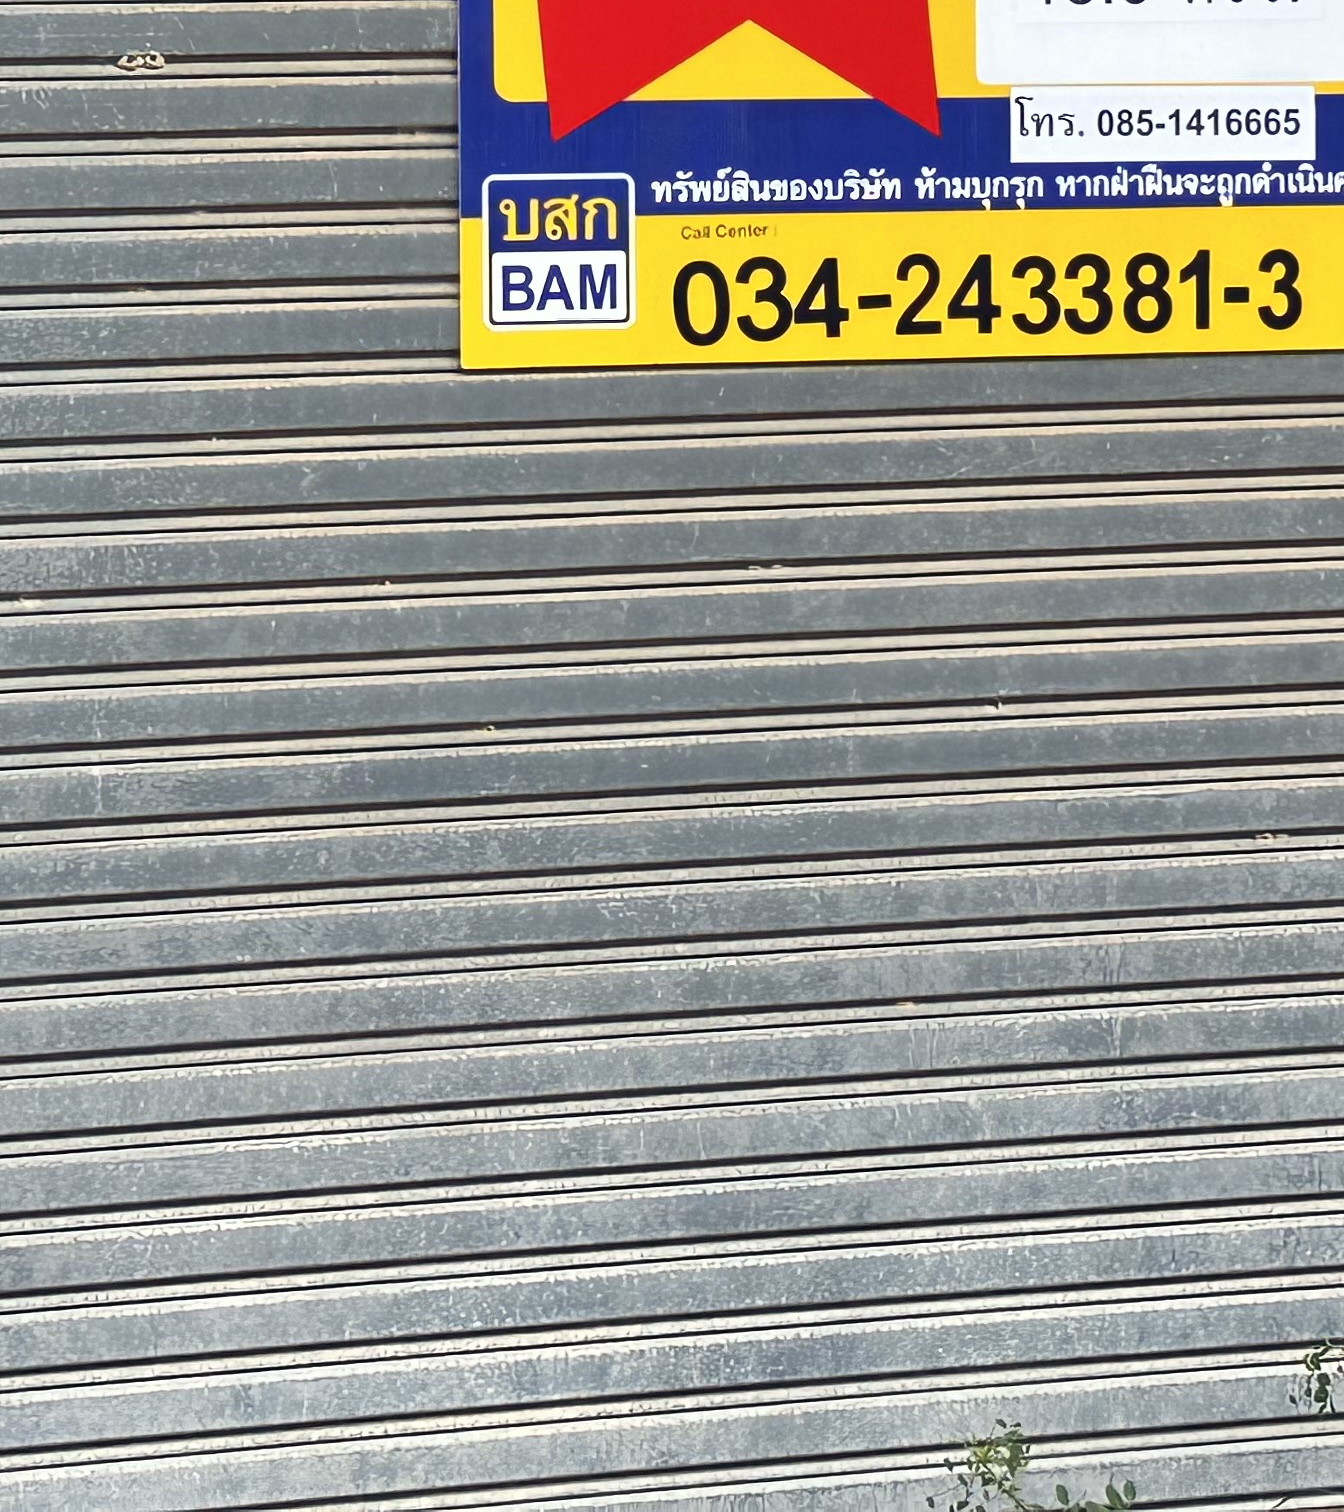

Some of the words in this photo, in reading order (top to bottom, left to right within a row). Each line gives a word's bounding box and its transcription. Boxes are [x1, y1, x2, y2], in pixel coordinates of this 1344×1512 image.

[1014, 97, 1085, 138] โทร.
[1096, 107, 1302, 138] 085-1416665
[650, 166, 902, 204] ทรัพย์สินของบริษัท
[914, 165, 1045, 210] ห้ามบุกรุก
[498, 193, 619, 243] บสก
[680, 224, 710, 240] Call
[501, 263, 618, 312] BAM
[672, 248, 1304, 348] 034-243381-3
